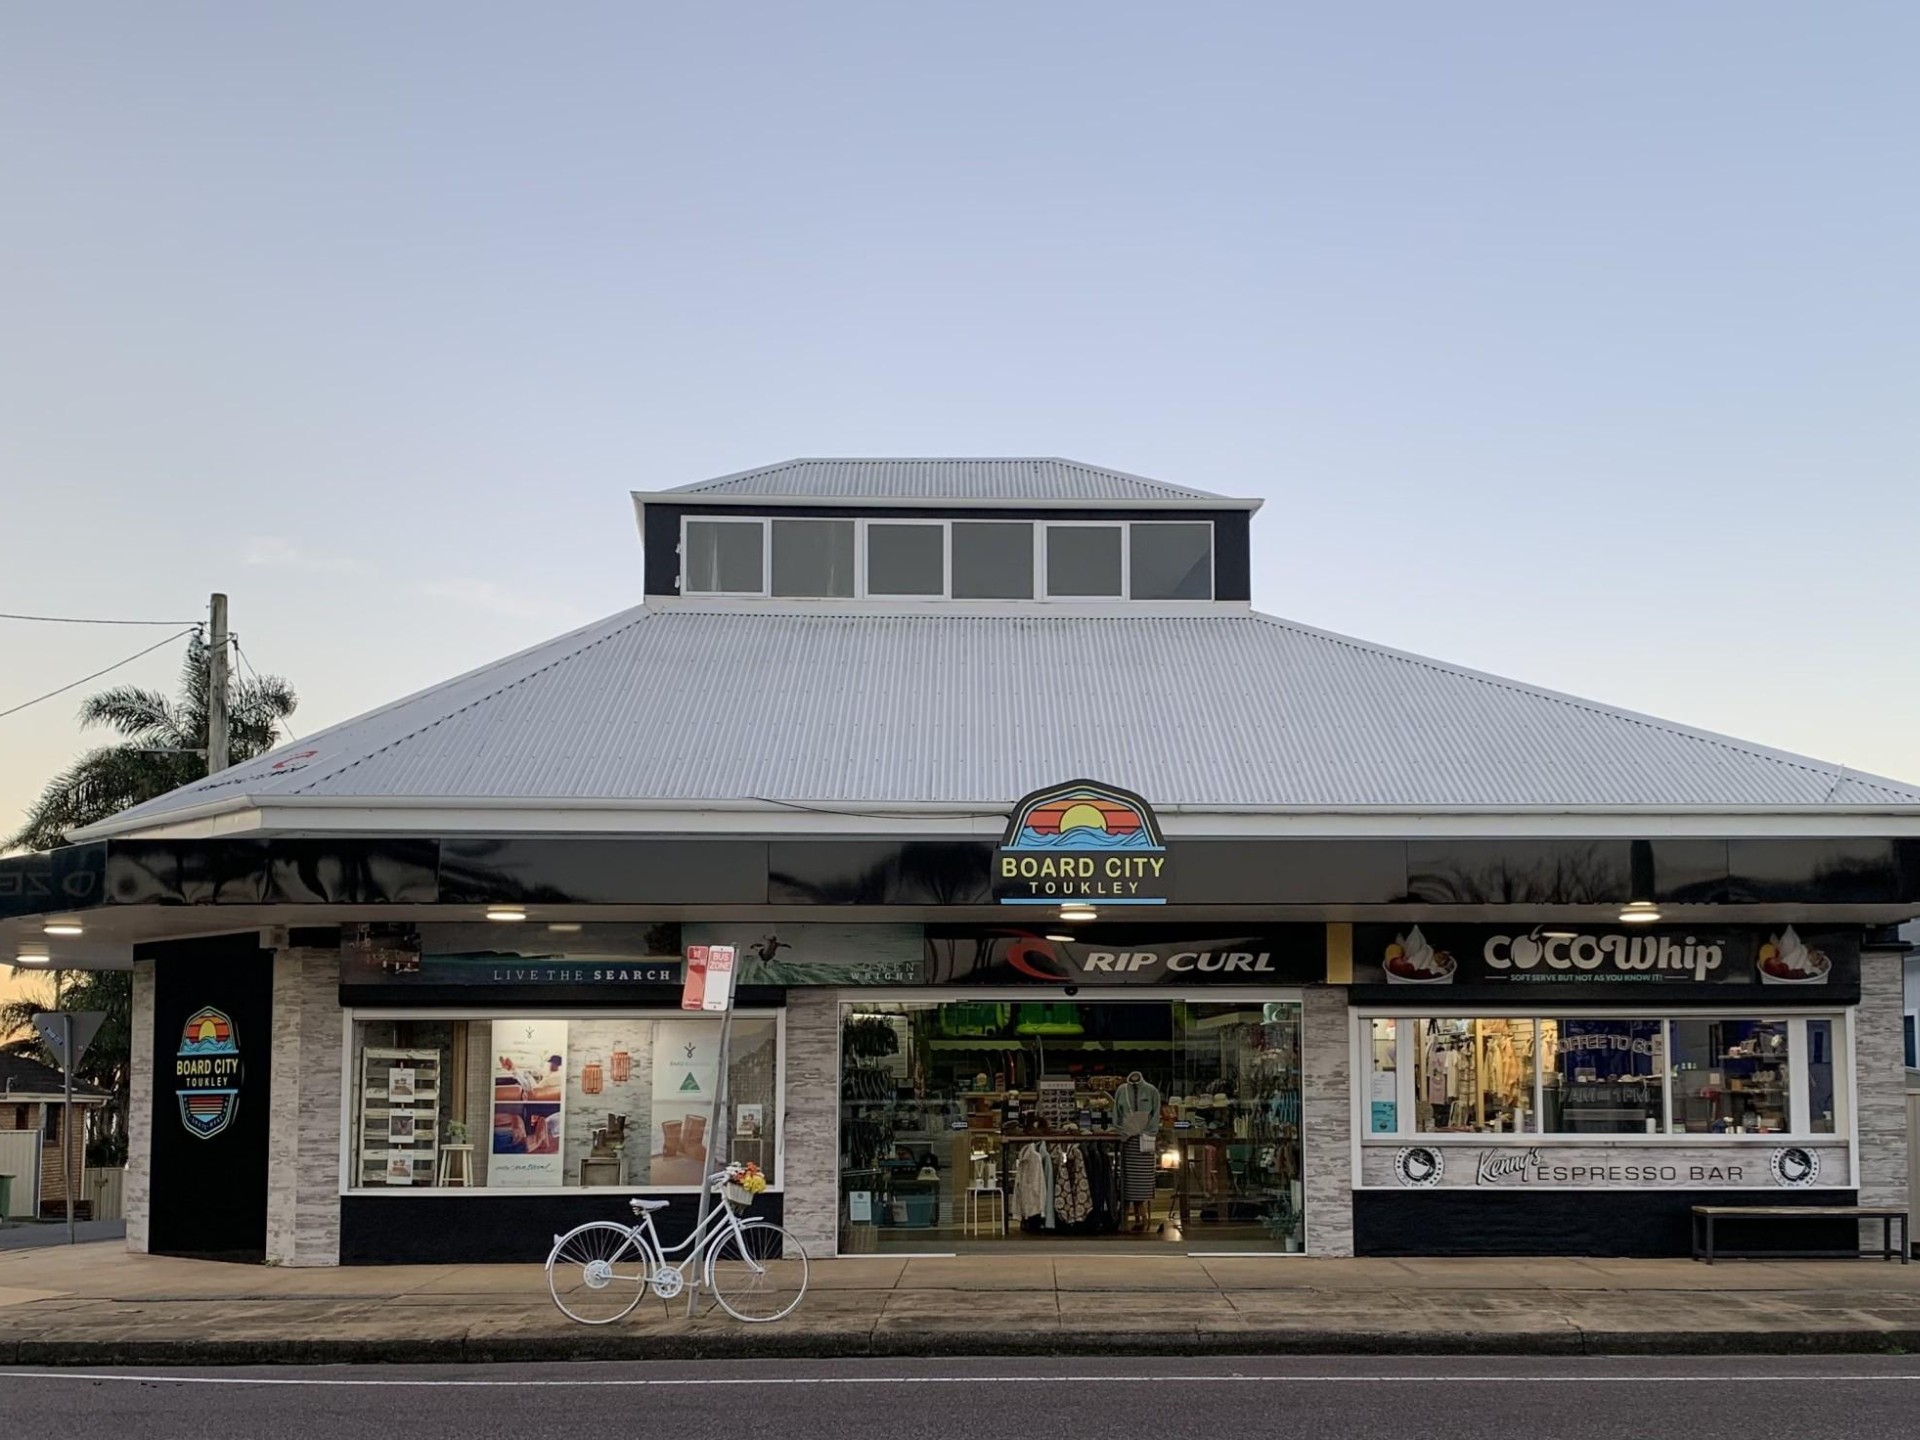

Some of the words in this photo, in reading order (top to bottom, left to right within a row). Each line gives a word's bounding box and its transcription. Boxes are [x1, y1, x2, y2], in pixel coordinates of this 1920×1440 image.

[1002, 857, 1095, 878] BOARD
[1105, 857, 1165, 878] CITY
[1029, 881, 1139, 895] TOUKLEY
[712, 952, 730, 962] BUS
[1083, 952, 1158, 972] RIP
[1166, 952, 1276, 972] CURL
[709, 961, 731, 970] ZONE
[493, 970, 539, 981] LIVE
[547, 970, 584, 981] THE
[593, 970, 671, 981] SEARCH
[851, 972, 915, 980] WRIGHT
[1510, 974, 1531, 982] SOFT
[1531, 974, 1557, 982] SERVE
[1558, 974, 1574, 982] BUT
[1574, 974, 1593, 982] NOT
[1593, 974, 1605, 982] AS
[1606, 974, 1624, 982] YOU
[1624, 974, 1651, 982] KNOW
[1608, 1034, 1631, 1051] TO
[176, 1059, 212, 1076] BOARD
[214, 1058, 239, 1074] CITY
[186, 1077, 228, 1087] TOUKLEY
[1476, 1146, 1542, 1185] Kenny's
[1537, 1166, 1677, 1181] ESPRESSO
[1690, 1166, 1744, 1181] BAR
